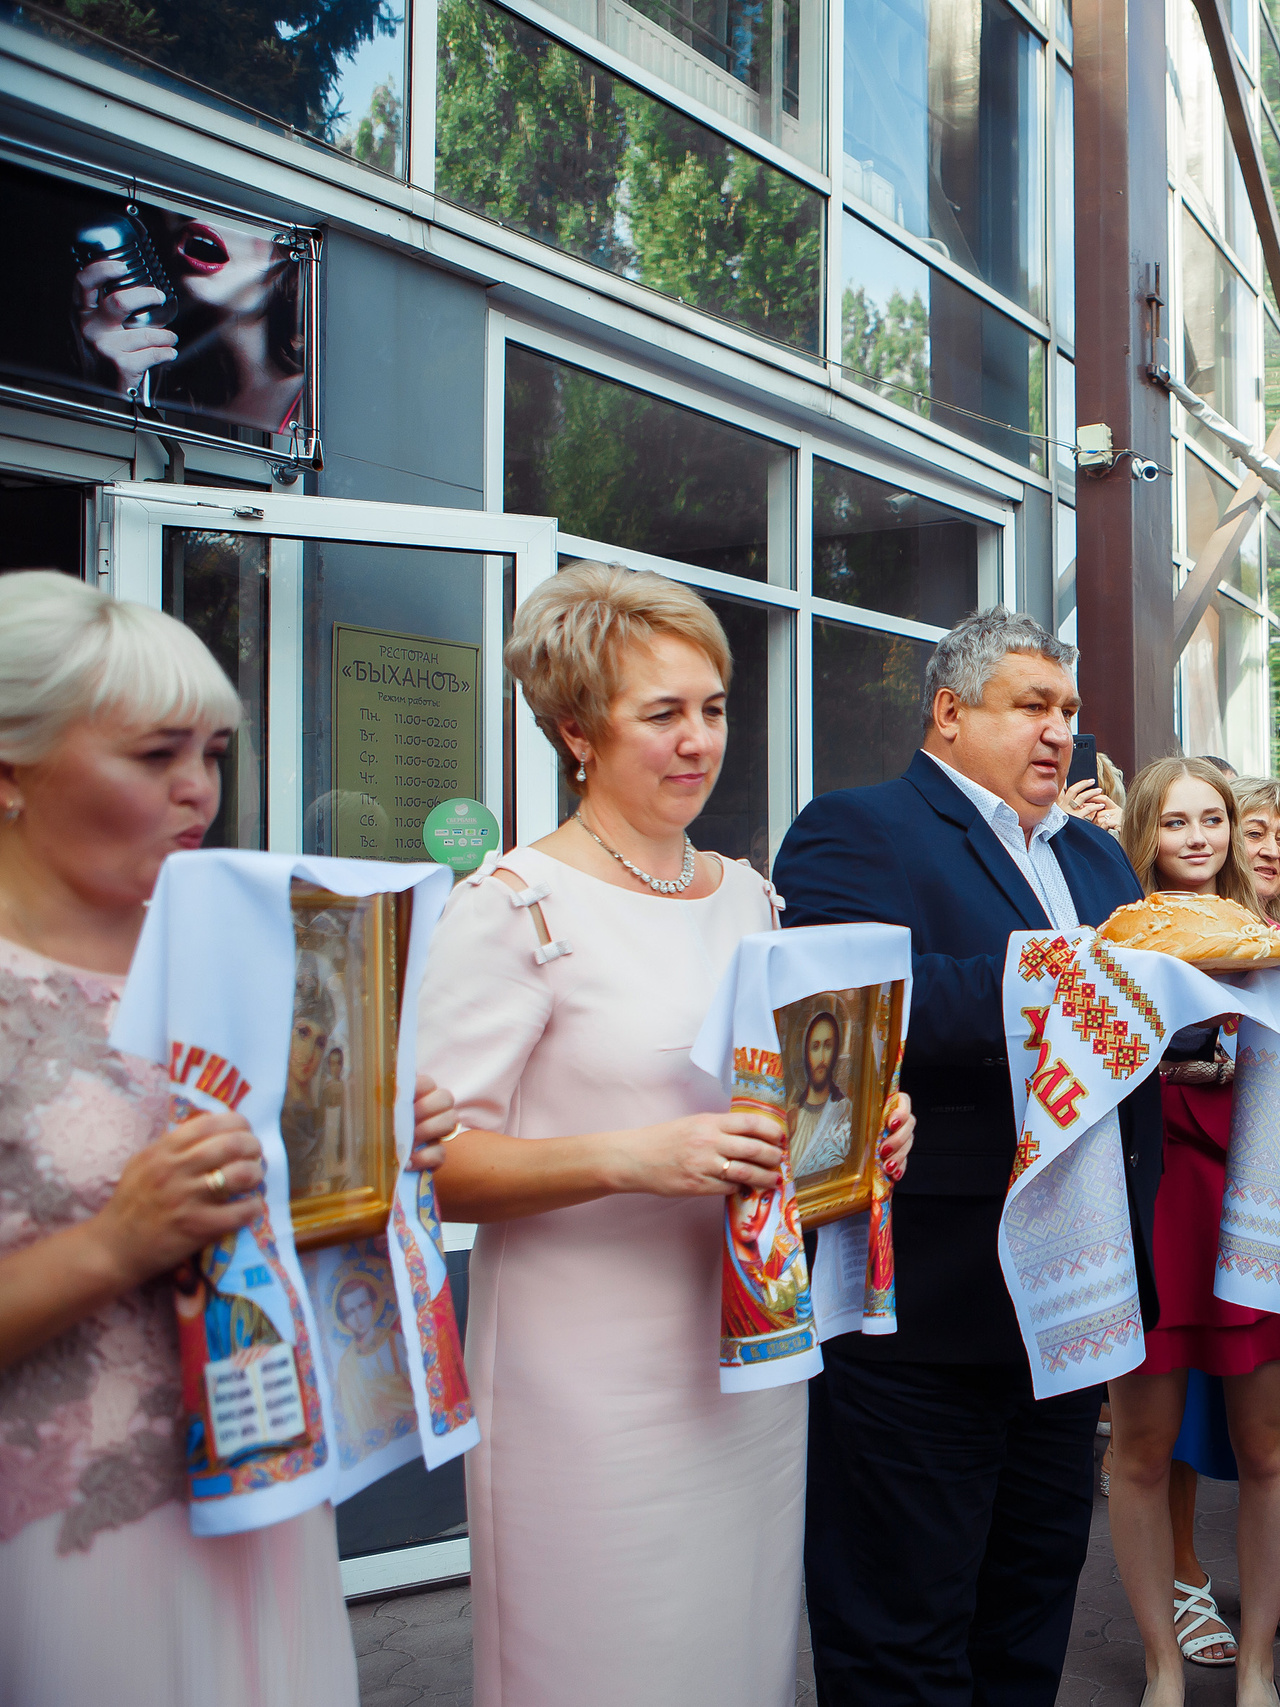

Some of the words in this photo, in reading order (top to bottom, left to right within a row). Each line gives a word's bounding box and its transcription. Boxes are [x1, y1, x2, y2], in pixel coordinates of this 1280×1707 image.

[379, 645, 439, 664] РЕСТОРАН
[342, 660, 471, 692] «БЫХАНОВ»
[378, 692, 406, 704] Режим
[408, 697, 441, 708] работы:
[360, 707, 380, 721] Пн.
[394, 713, 458, 729] 11.00-02.00
[360, 729, 378, 742] Вт.
[394, 734, 458, 749] 11.00-02.00
[360, 750, 378, 766] Ср.
[394, 755, 458, 769] 11.00-02.00
[360, 771, 378, 785] Чт.
[394, 776, 458, 789] 11.00-02.00
[360, 793, 380, 805] Пт.
[360, 814, 377, 826] Сб.
[360, 835, 378, 848] Вс.
